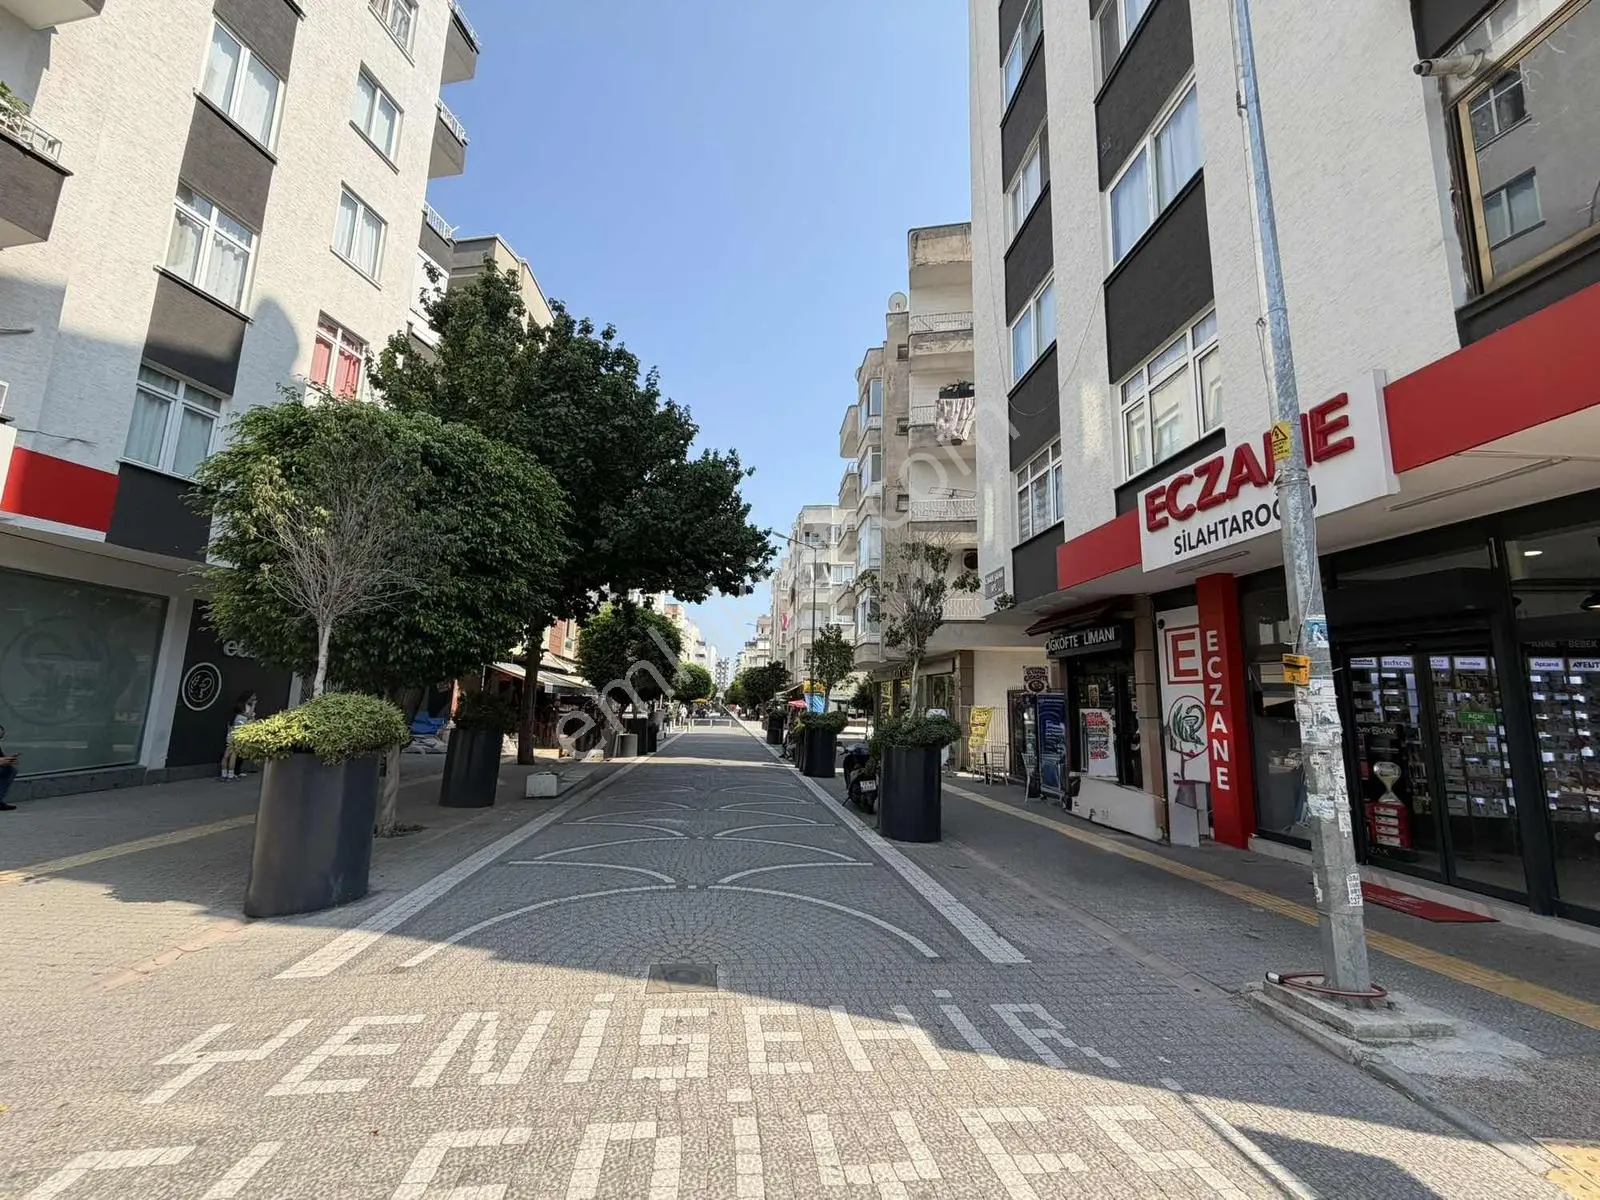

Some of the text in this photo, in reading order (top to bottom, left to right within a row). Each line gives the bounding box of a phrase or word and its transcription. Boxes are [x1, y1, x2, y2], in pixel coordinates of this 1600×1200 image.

[1174, 484, 1316, 556] SİLAHTARO
[1083, 626, 1116, 646] LİMANI
[1170, 631, 1200, 678] E
[1205, 629, 1232, 791] ECZANE
[143, 990, 1121, 1104] YENİŞEHİR
